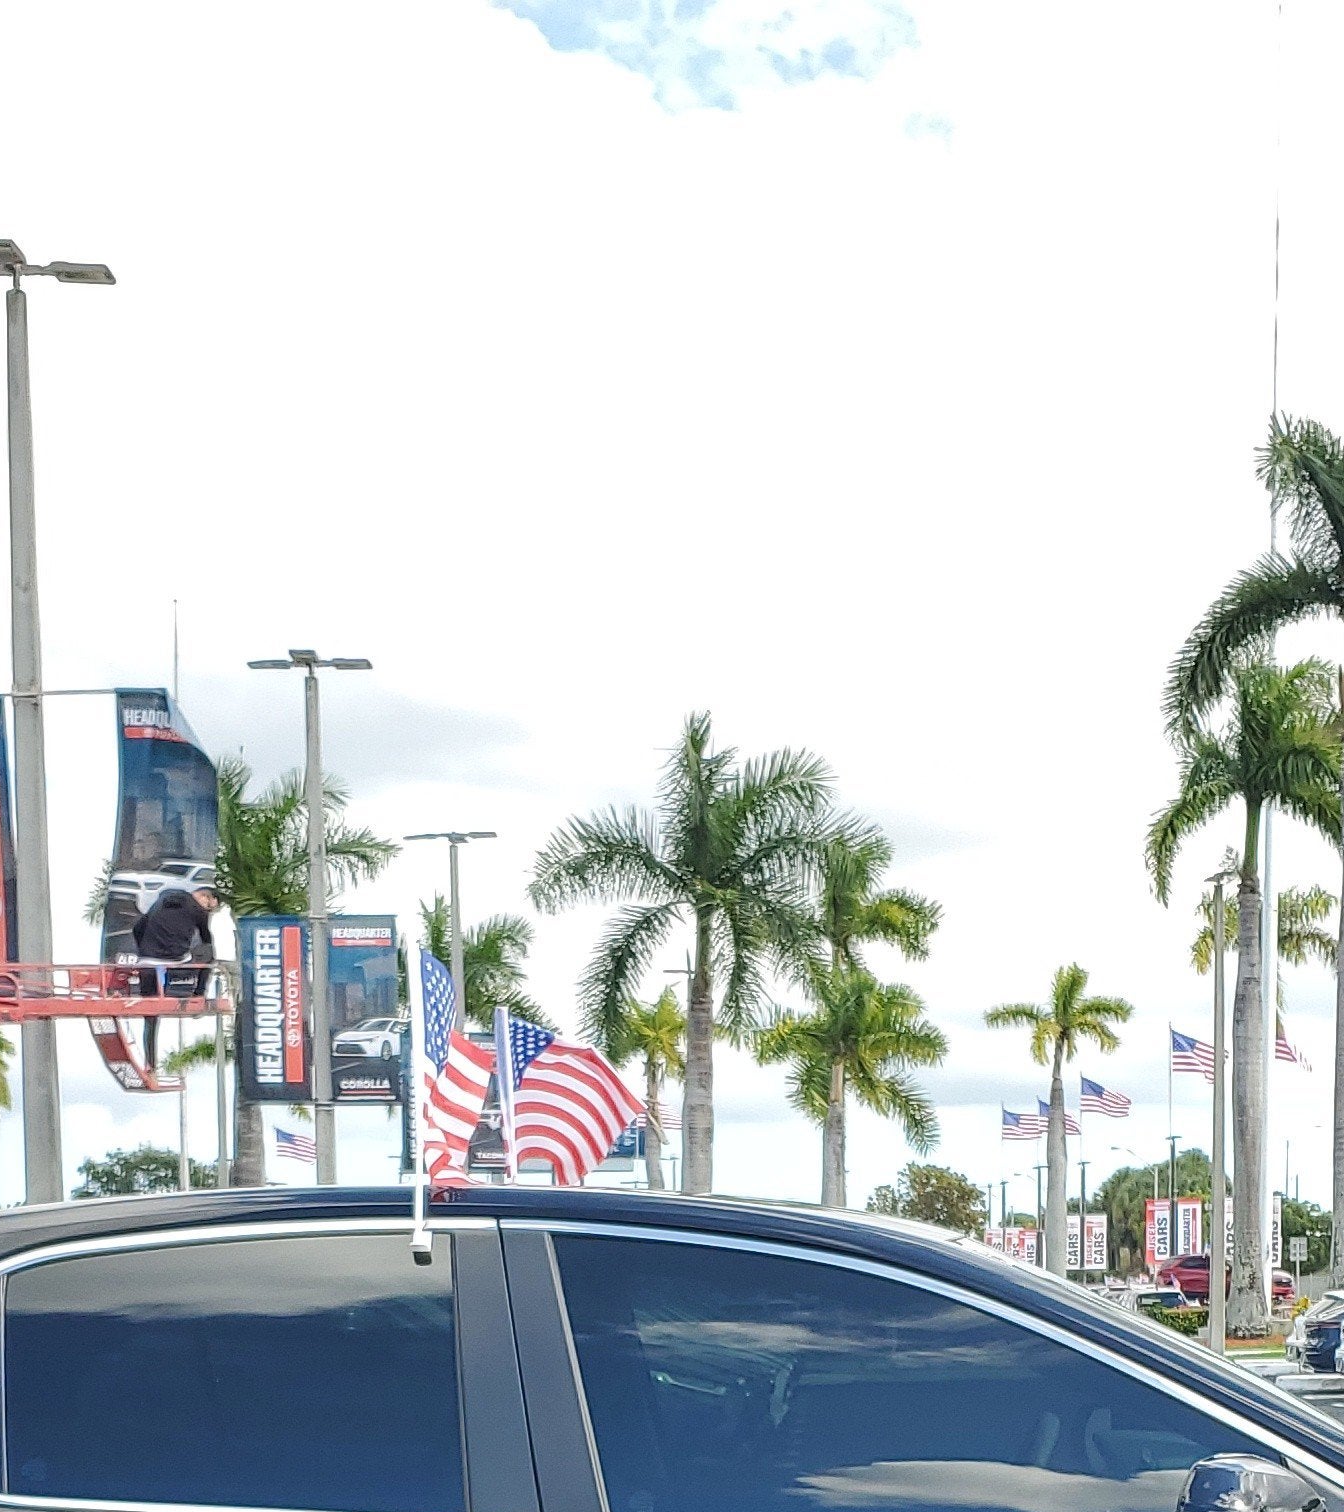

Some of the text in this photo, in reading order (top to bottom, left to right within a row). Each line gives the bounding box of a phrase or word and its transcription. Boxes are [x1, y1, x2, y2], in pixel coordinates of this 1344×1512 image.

[253, 929, 285, 1084] HEADQUARTER
[286, 969, 300, 1026] TOYOTA
[1068, 1233, 1078, 1265] CARS
[1094, 1232, 1104, 1265] CARS
[1148, 1223, 1156, 1251] USED
[1157, 1217, 1168, 1256] CARS
